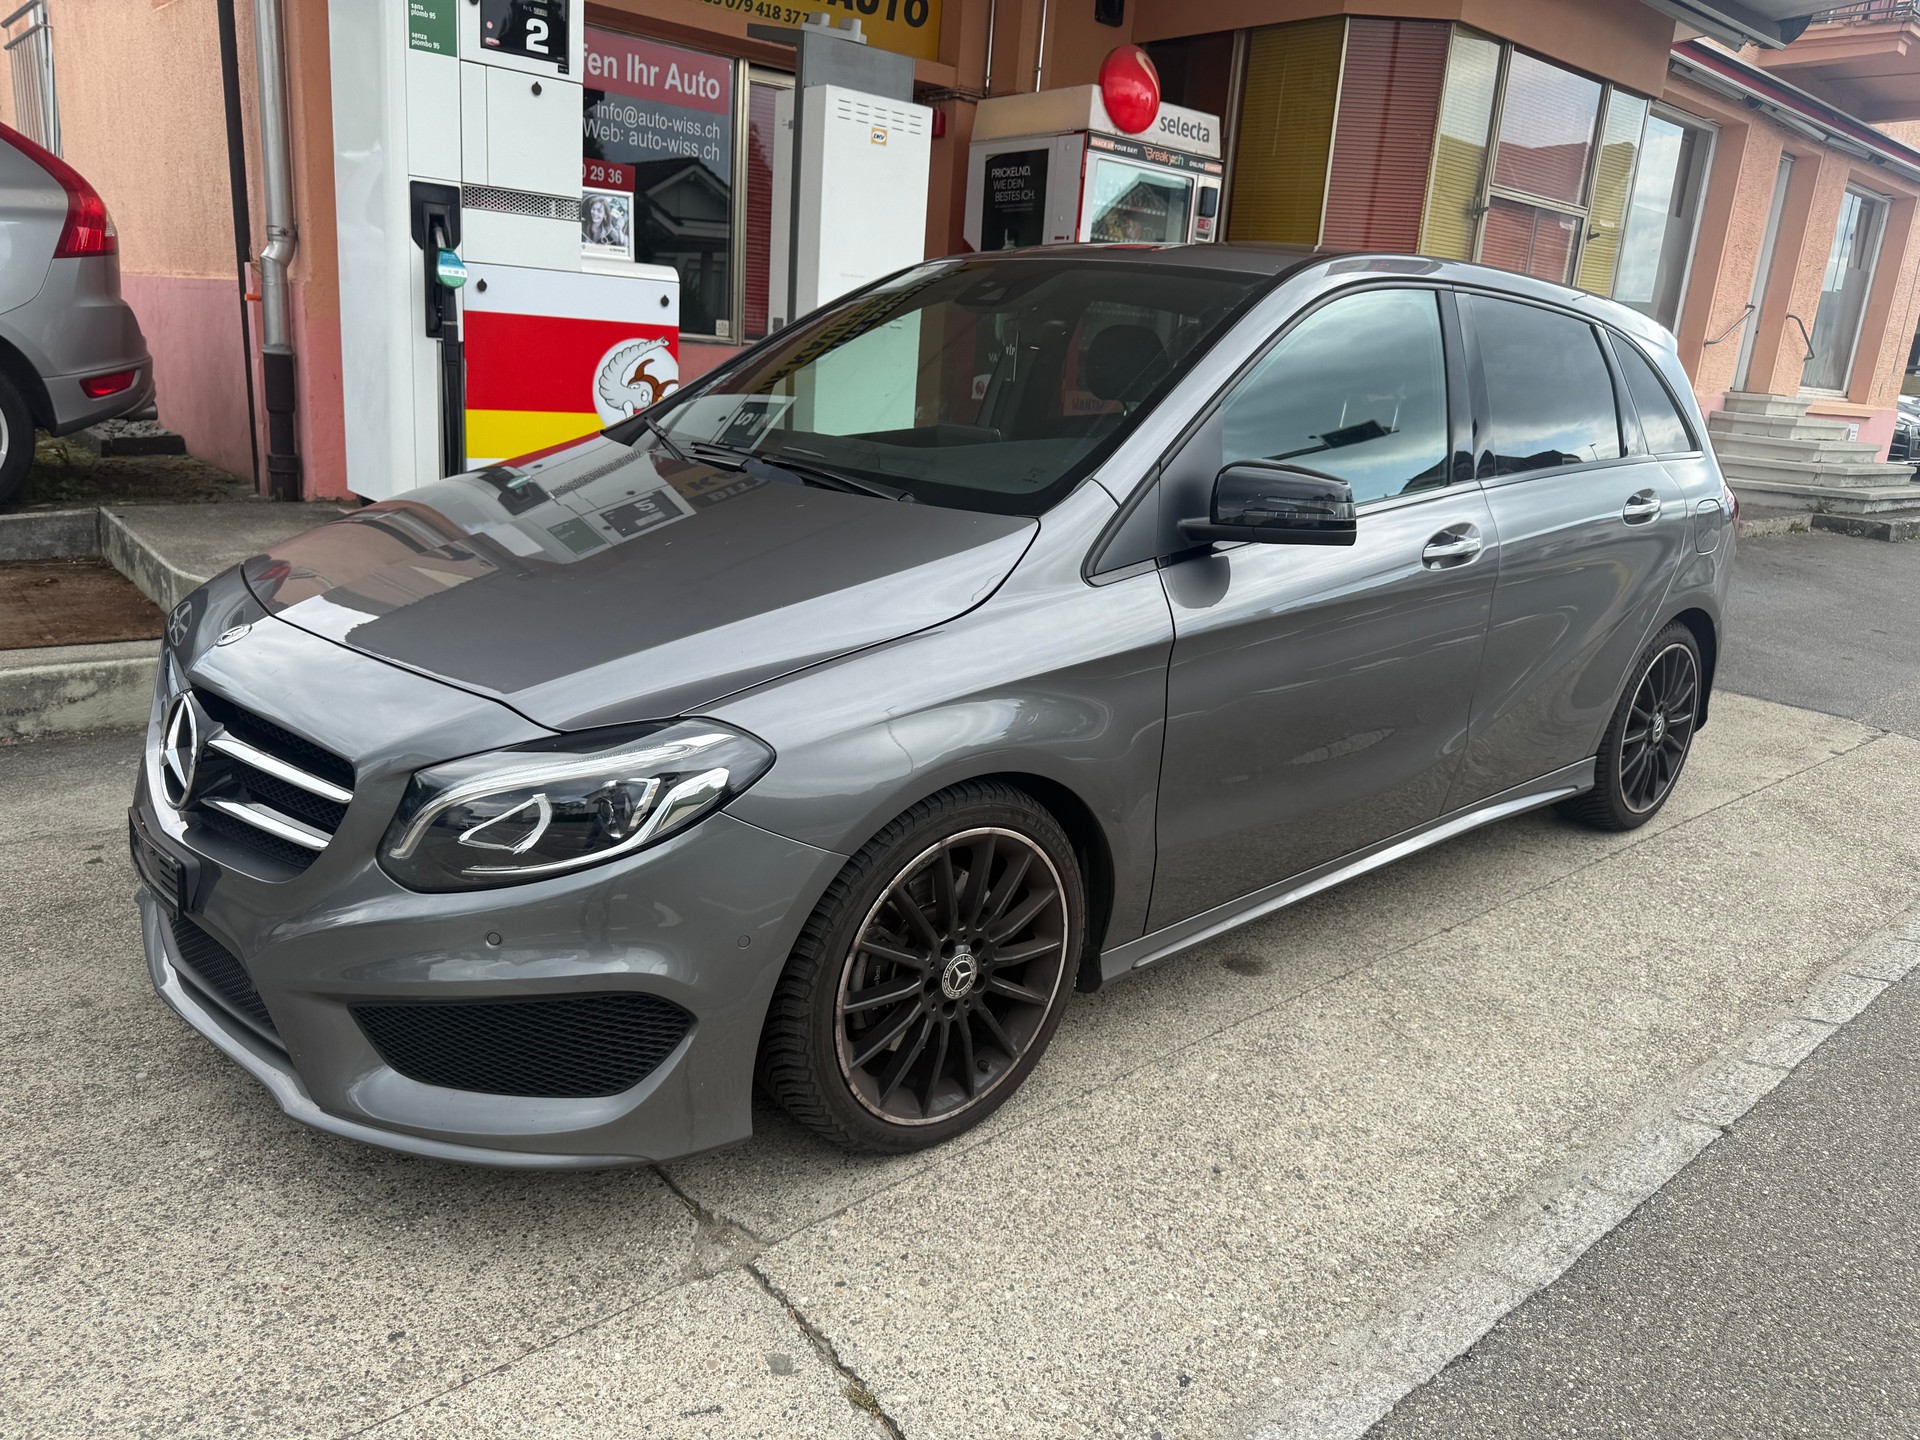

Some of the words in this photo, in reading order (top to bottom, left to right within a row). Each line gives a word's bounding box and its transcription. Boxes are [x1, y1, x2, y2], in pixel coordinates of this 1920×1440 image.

[411, 3, 424, 11] sans
[411, 9, 428, 18] plomb
[429, 12, 436, 20] 95
[755, 2, 781, 20] 418
[411, 32, 427, 40] senza
[526, 17, 549, 55] 2
[433, 42, 440, 50] 95
[583, 43, 617, 79] en
[626, 53, 659, 87] Ihr
[664, 62, 720, 100] Auto
[596, 100, 720, 139] info@auto-wiss.ch
[1159, 116, 1210, 143] selecta
[583, 117, 624, 143] Web:
[628, 130, 720, 161] auto-wiss.ch
[590, 165, 605, 182] 29
[608, 168, 623, 185] 36
[991, 165, 1031, 178] PRICKELND,
[993, 180, 1006, 190] WIE
[1007, 178, 1025, 189] DEIN
[995, 190, 1020, 202] BESTES
